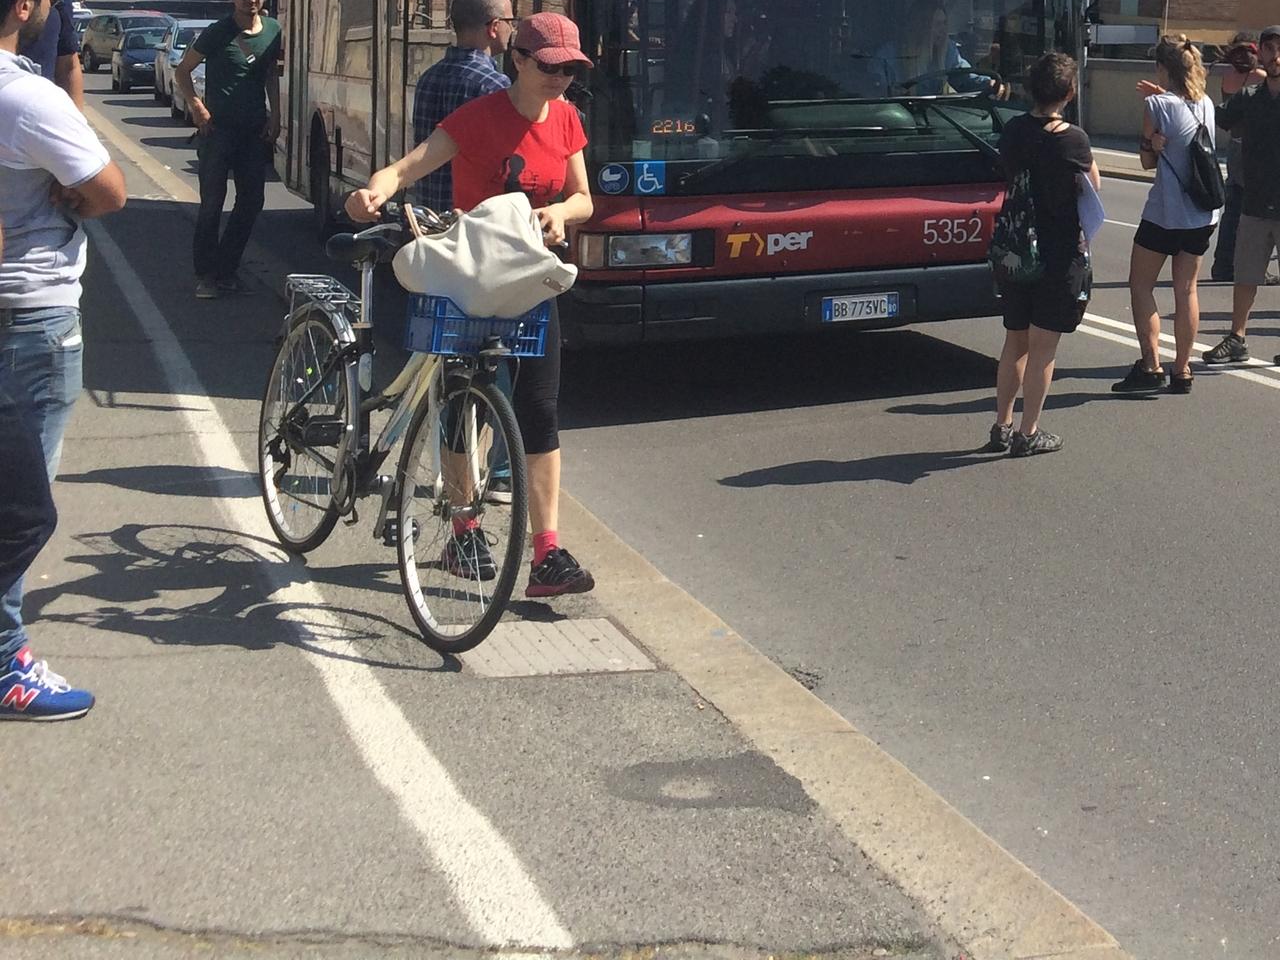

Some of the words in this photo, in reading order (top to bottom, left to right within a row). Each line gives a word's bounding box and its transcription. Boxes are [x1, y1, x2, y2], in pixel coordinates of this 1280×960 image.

[652, 119, 695, 133] 2216
[923, 218, 982, 245] 5352
[1, 683, 40, 711] N
